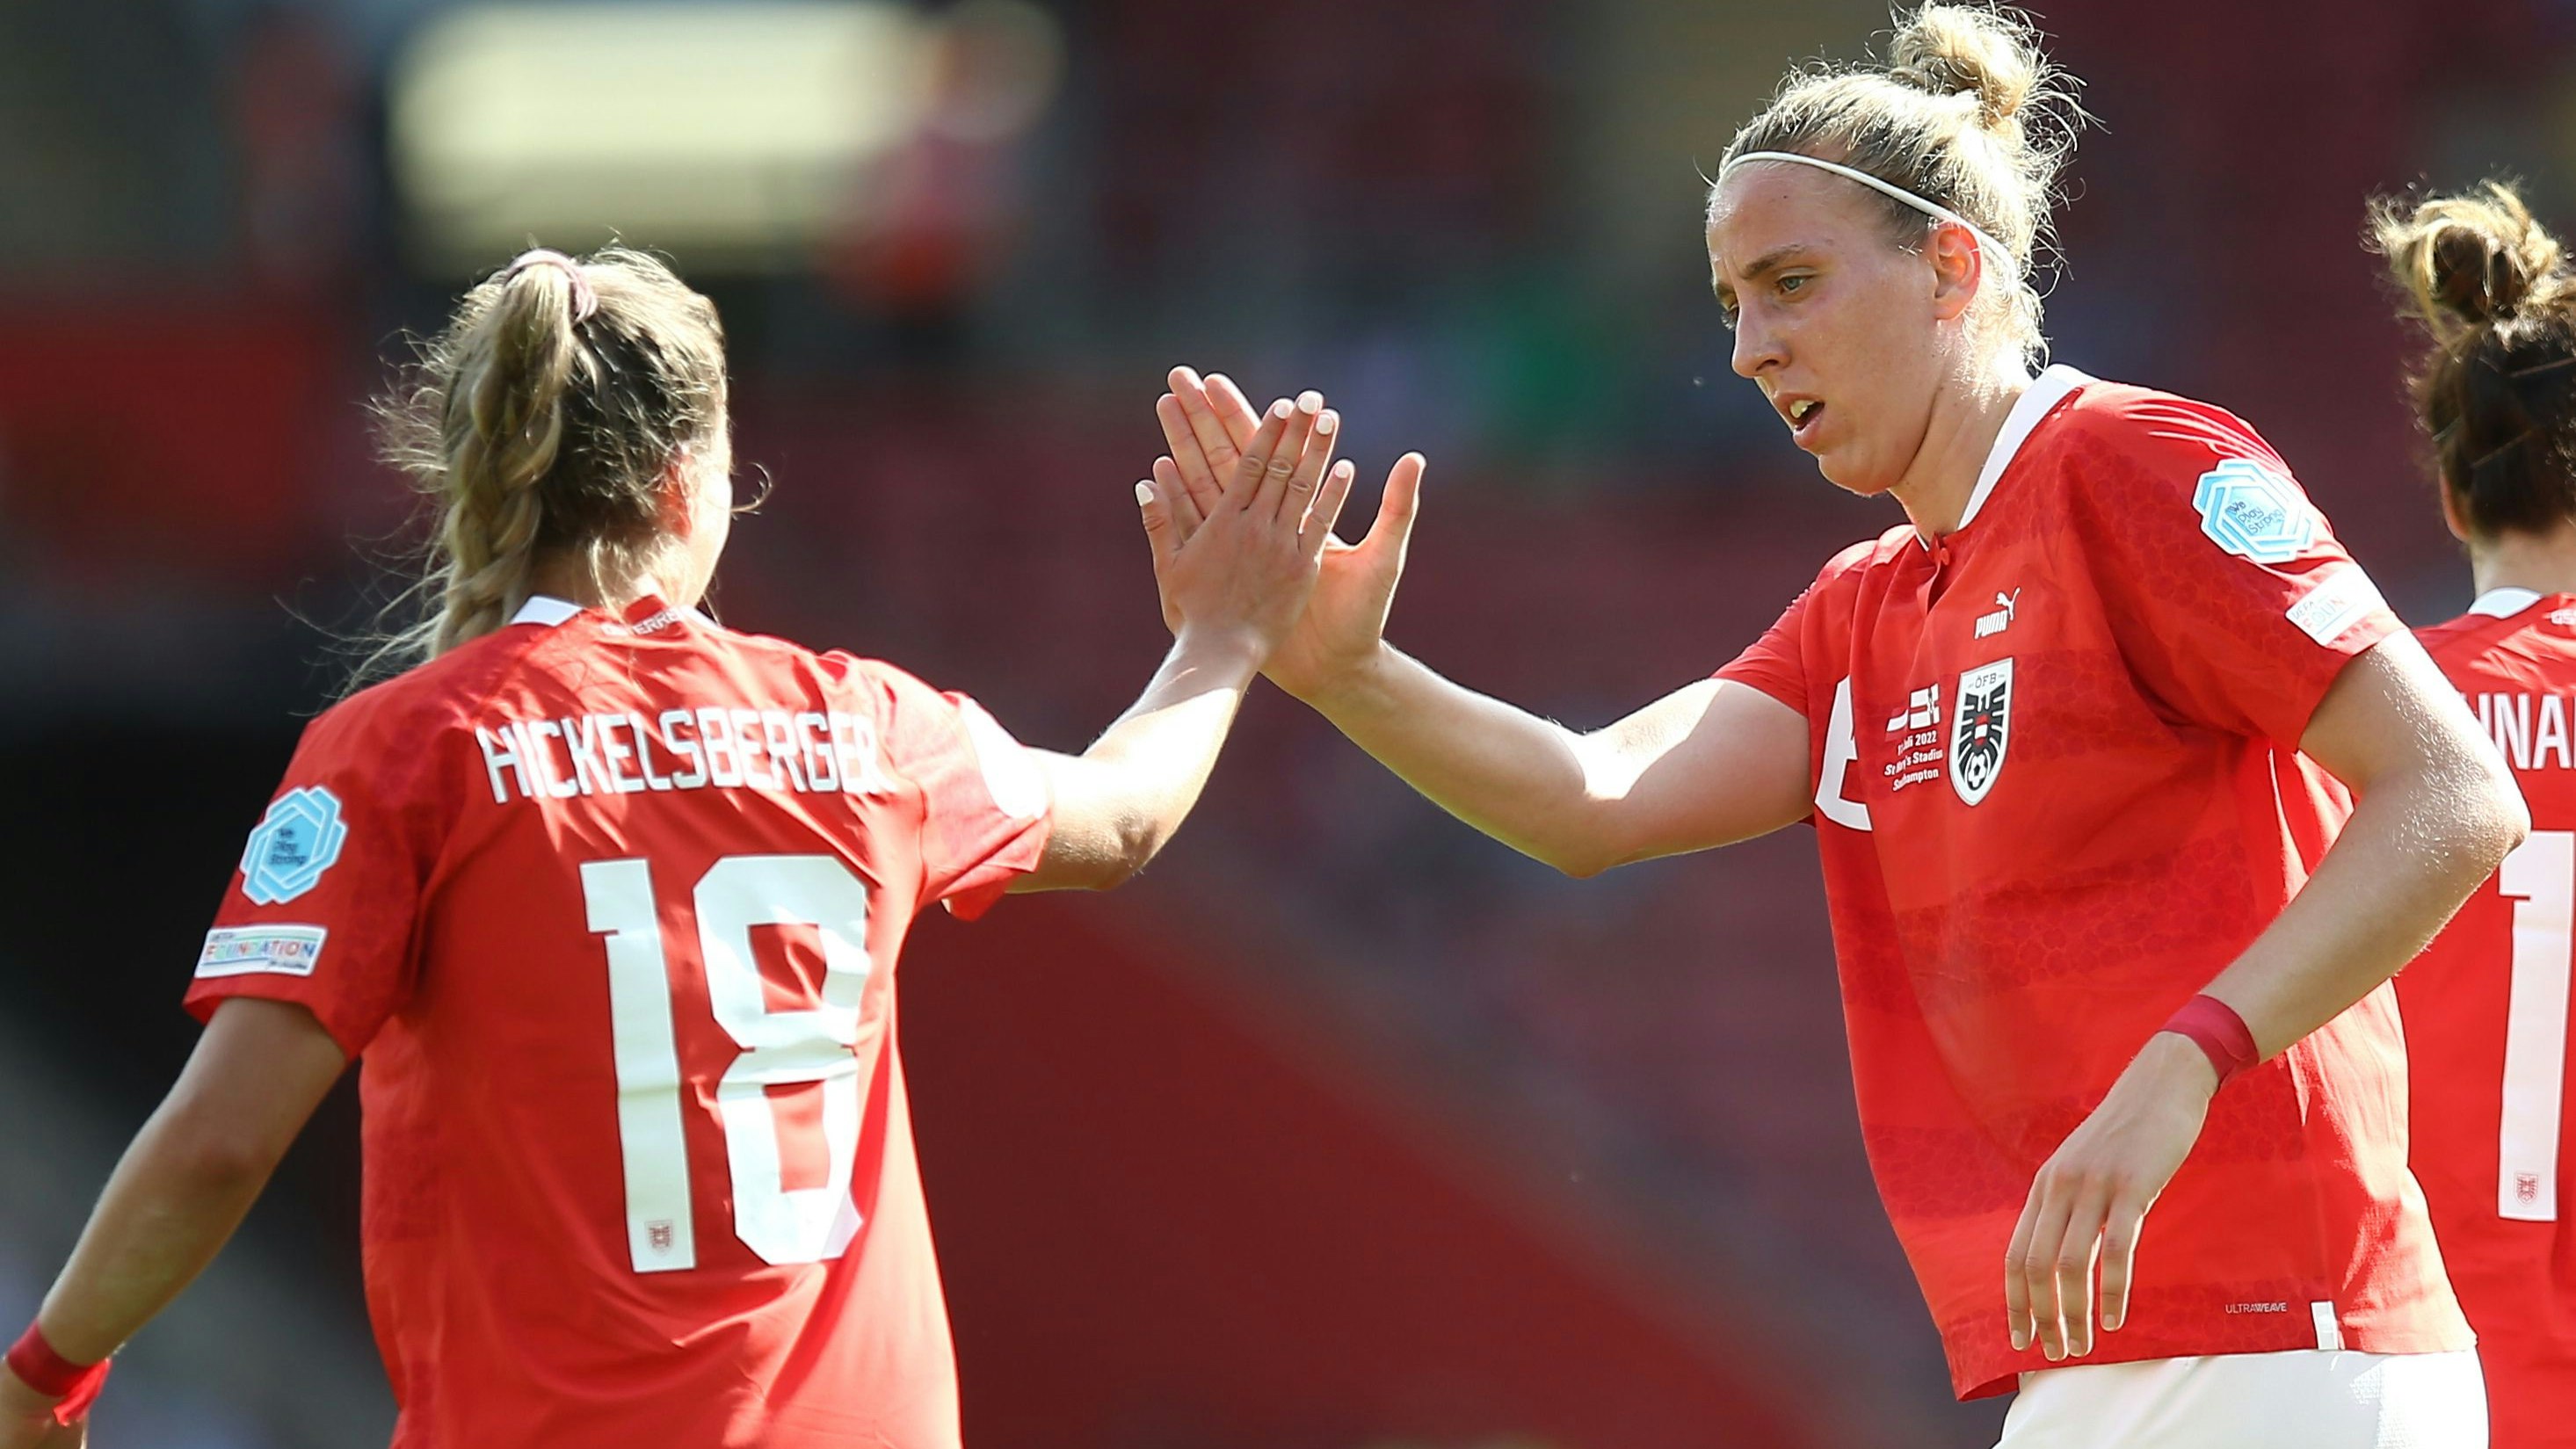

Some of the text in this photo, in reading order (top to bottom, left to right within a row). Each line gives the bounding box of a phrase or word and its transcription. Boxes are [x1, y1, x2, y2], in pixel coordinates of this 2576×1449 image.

[1974, 609, 2008, 640] PUMA
[1975, 672, 1997, 689] ÖFB
[1915, 730, 1937, 747] 2022
[474, 707, 897, 804] HICKELSBERGER
[2499, 831, 2575, 1220] 1
[579, 854, 871, 1272] 18
[2225, 1302, 2288, 1314] ULTRAWEAVE
